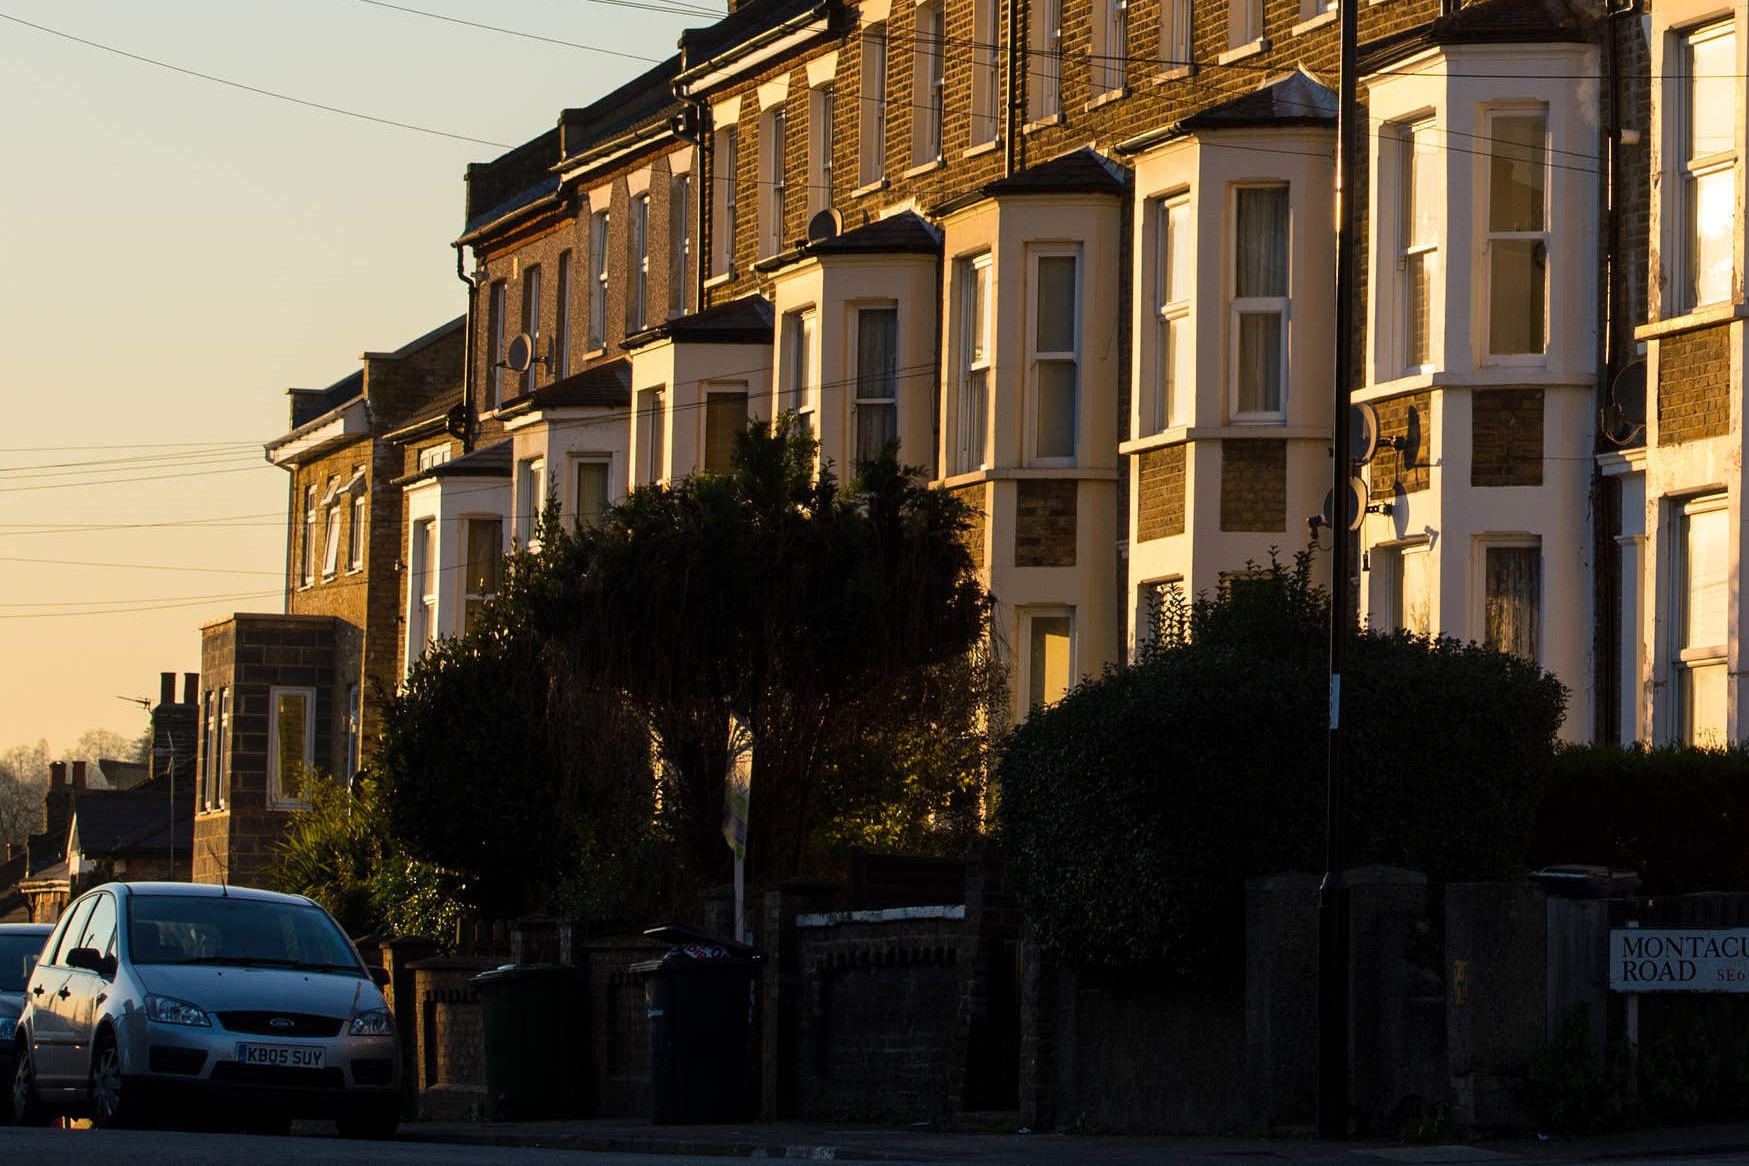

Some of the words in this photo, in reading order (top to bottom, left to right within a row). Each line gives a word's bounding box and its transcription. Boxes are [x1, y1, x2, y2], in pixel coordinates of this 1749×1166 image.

[1622, 960, 1696, 982] ROAD
[1717, 968, 1746, 982] SE6
[247, 1047, 289, 1064] KB05
[292, 1049, 322, 1067] SUY
